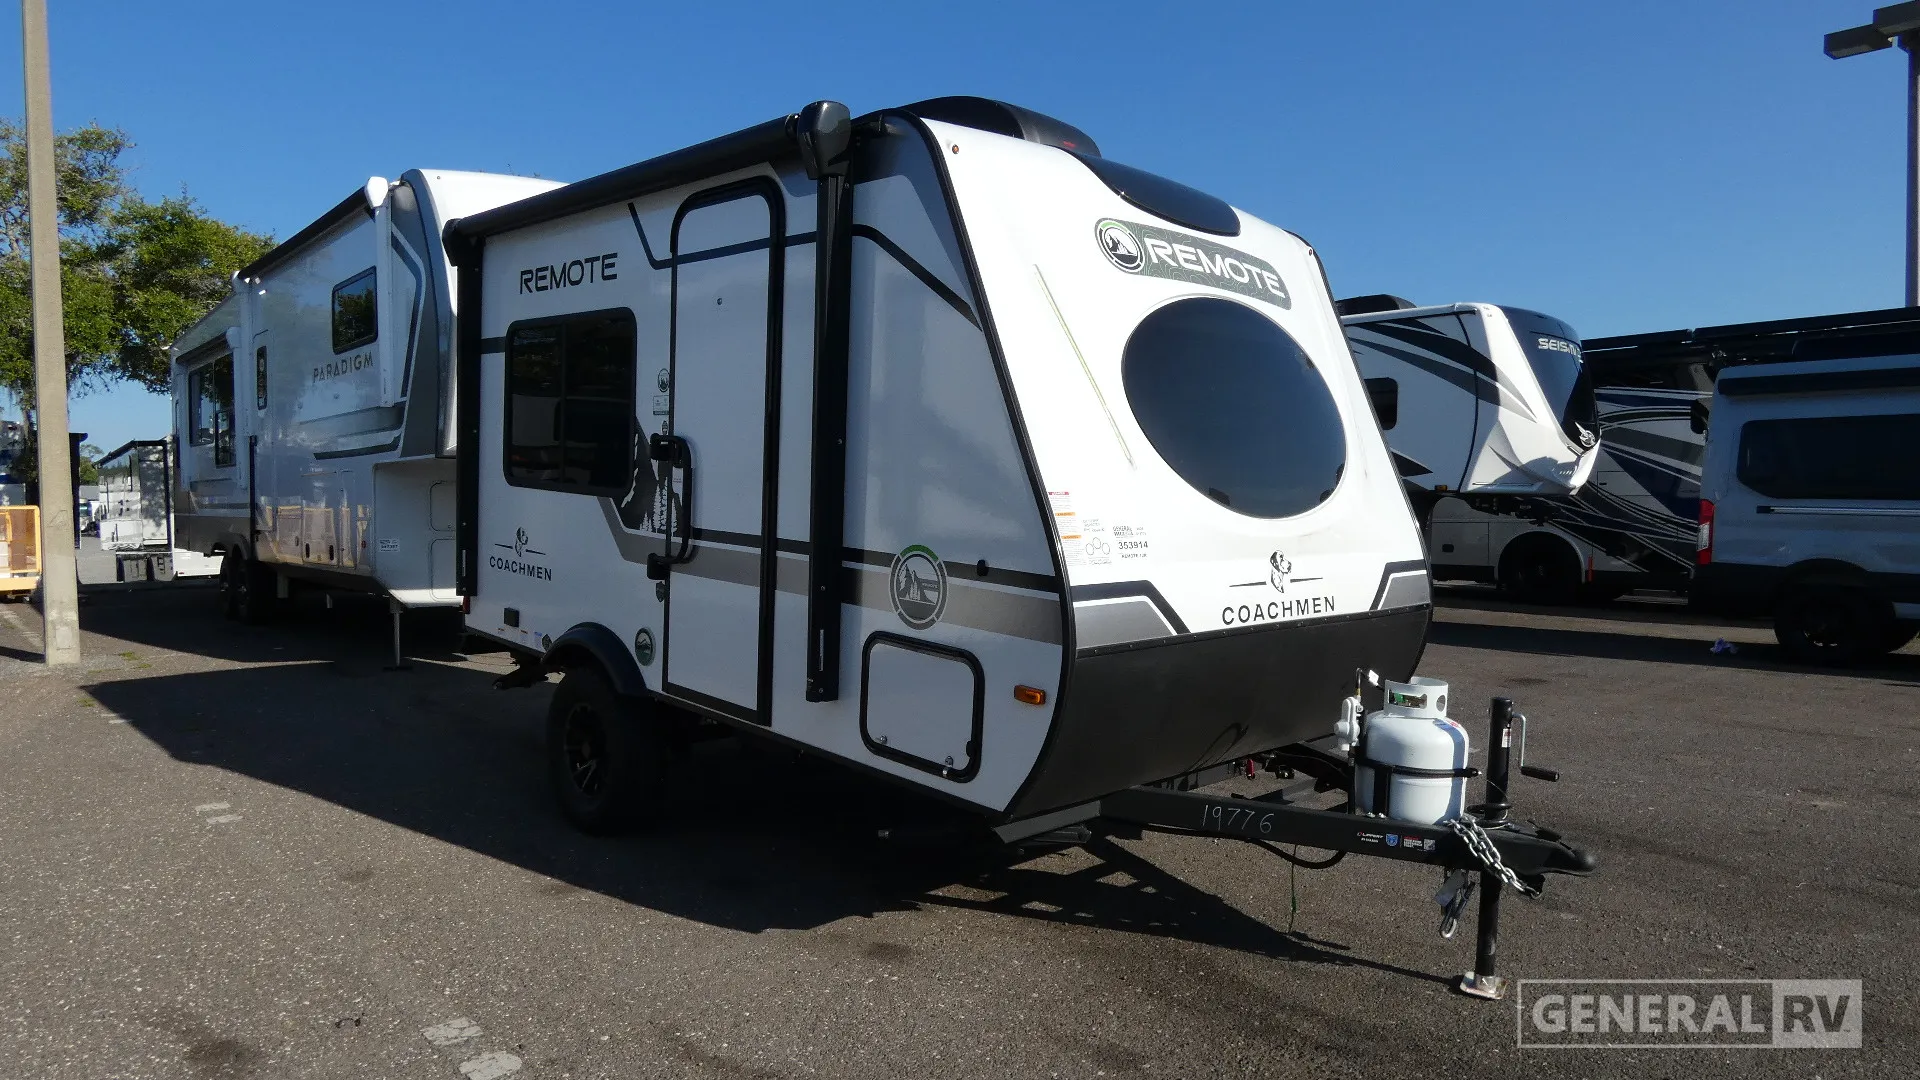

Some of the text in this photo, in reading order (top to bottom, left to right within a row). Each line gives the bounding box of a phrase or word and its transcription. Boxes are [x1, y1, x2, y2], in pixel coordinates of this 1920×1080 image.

[519, 252, 618, 295] REMOTE
[1143, 237, 1286, 299] REMOTE
[1538, 338, 1583, 358] SEISM
[312, 350, 374, 384] PARADIGM
[1118, 541, 1148, 550] 353914
[489, 555, 552, 581] COACHMEN
[1222, 595, 1335, 625] COACHMEN
[1202, 804, 1274, 834] 19776
